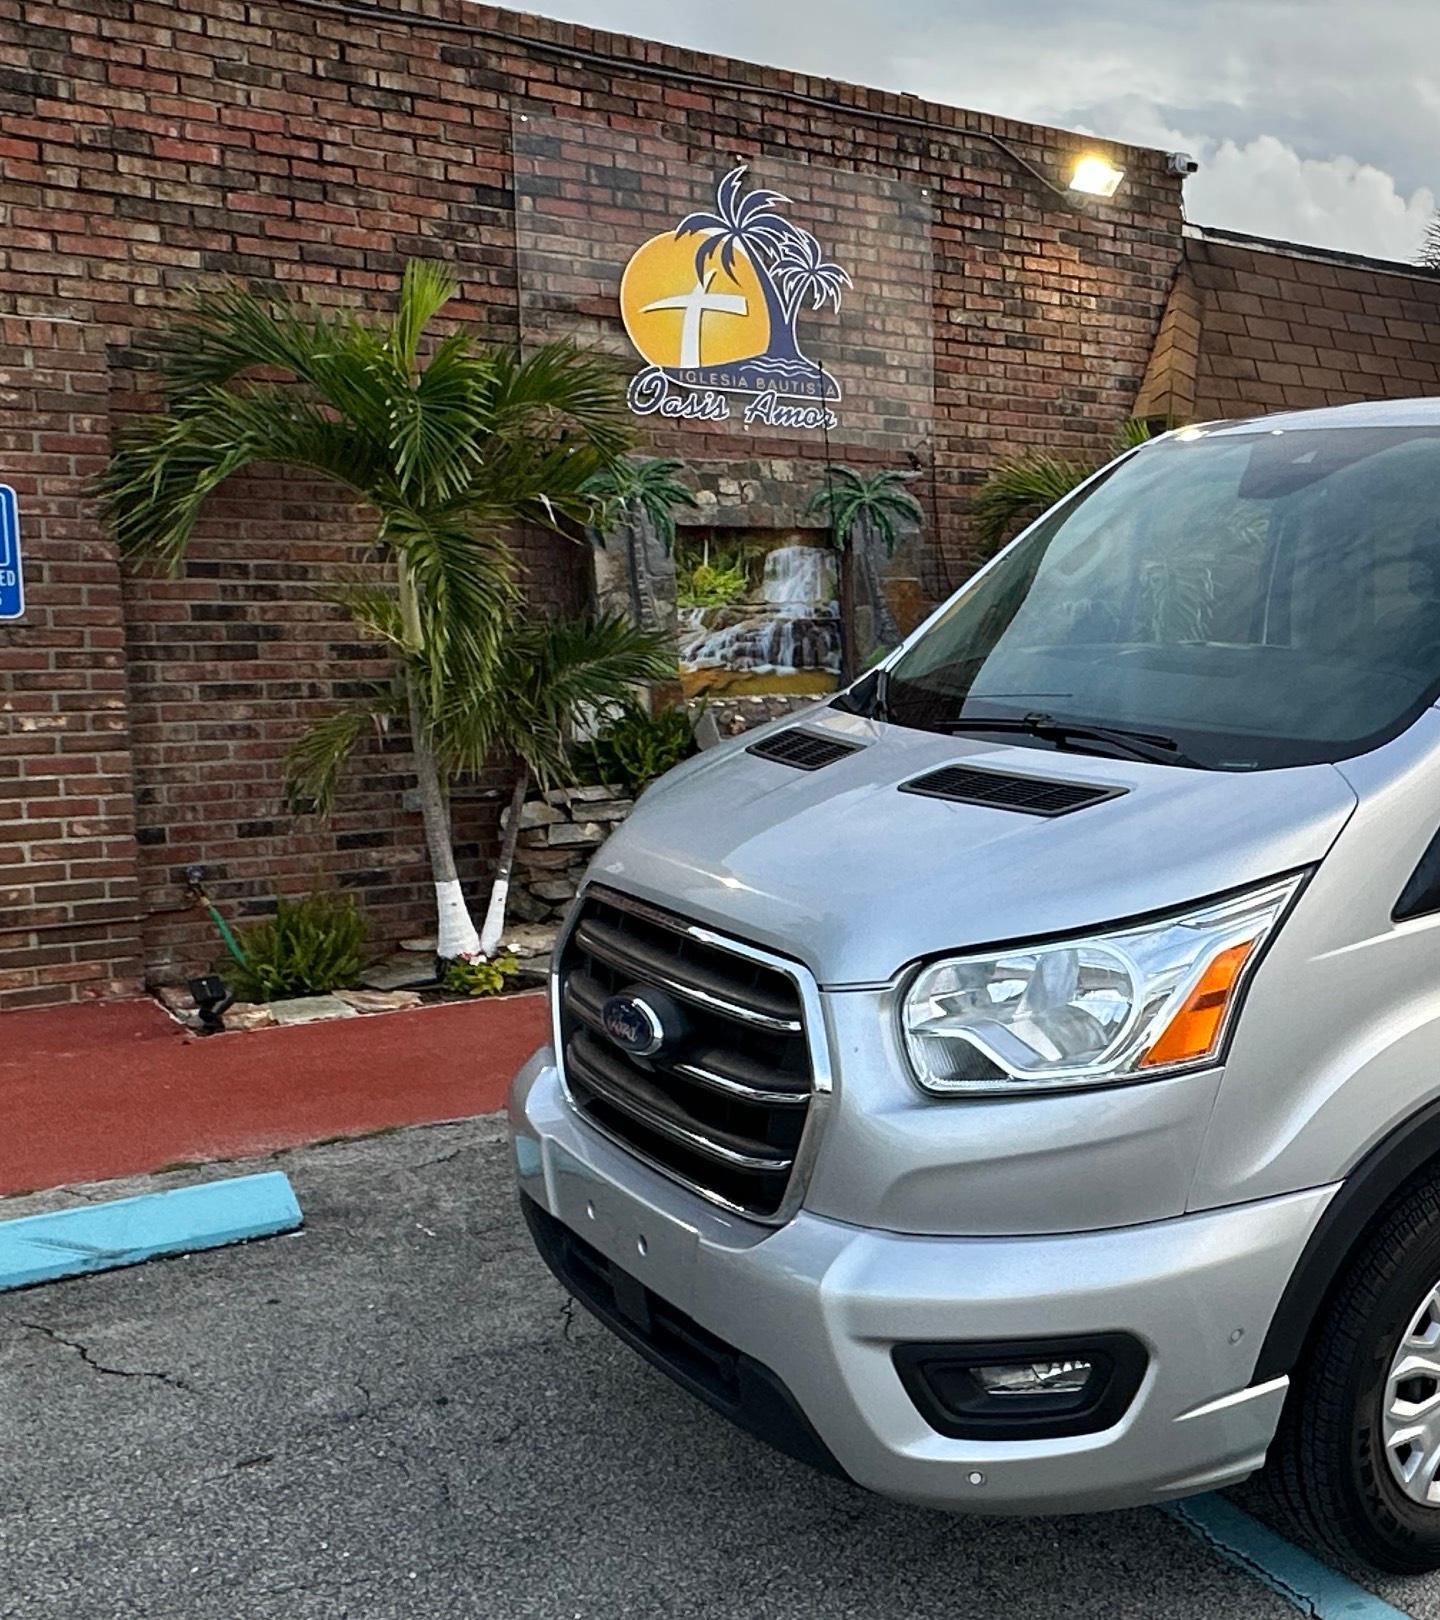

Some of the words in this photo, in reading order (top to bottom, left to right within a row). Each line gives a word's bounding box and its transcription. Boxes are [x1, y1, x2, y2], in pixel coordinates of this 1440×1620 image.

[627, 365, 730, 422] Oasis
[744, 388, 838, 431] Amor
[679, 370, 748, 388] IGLESIA
